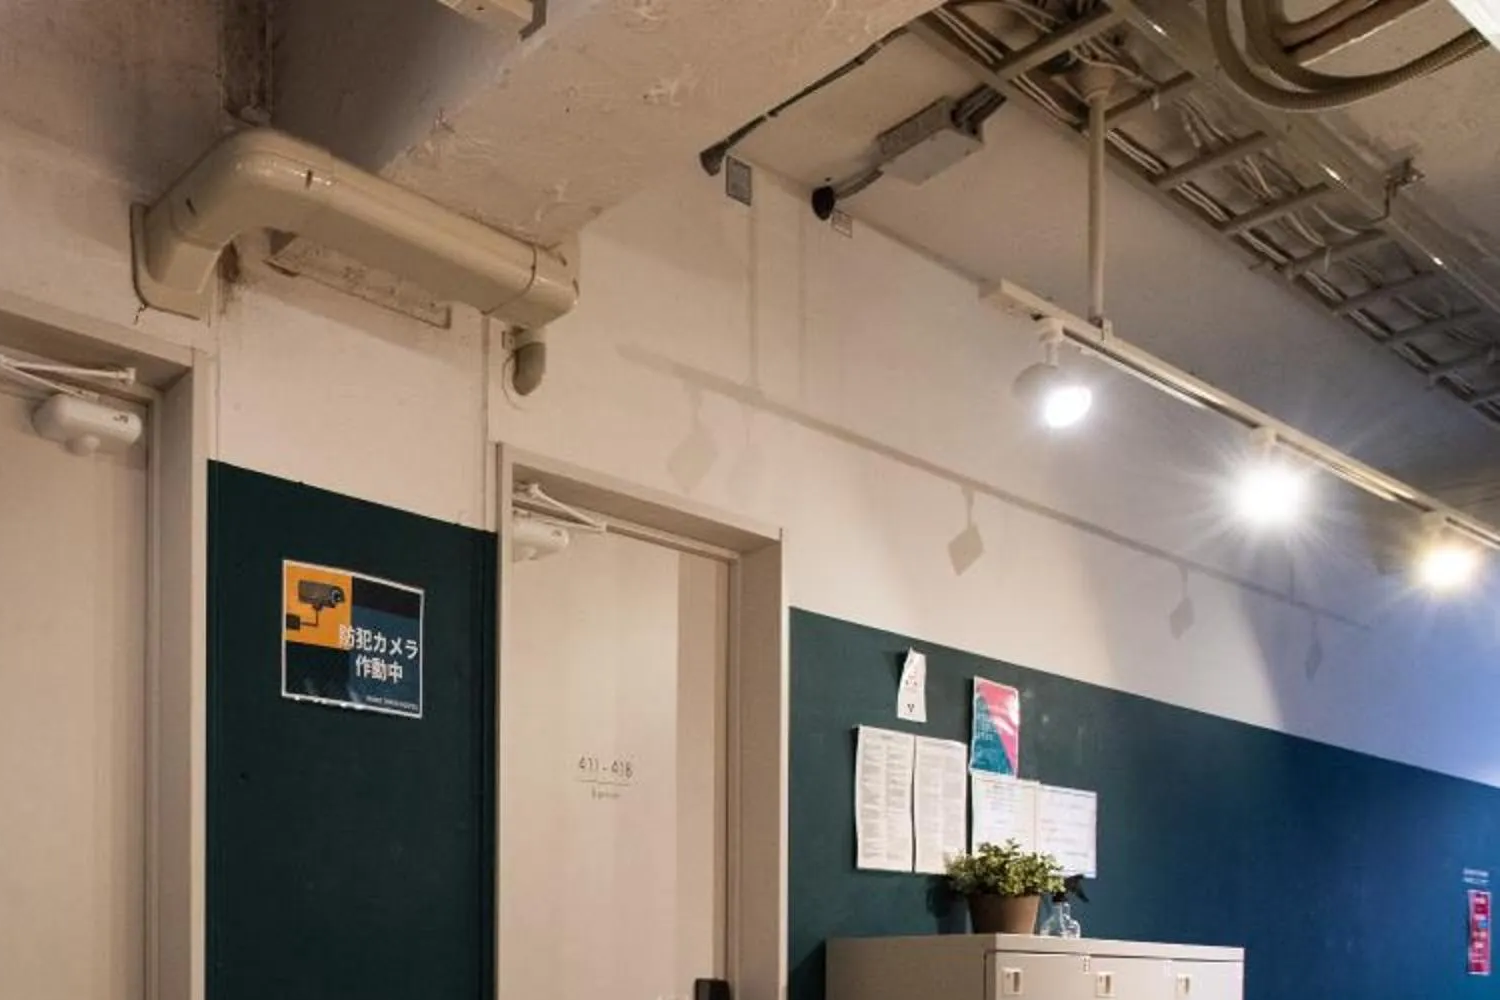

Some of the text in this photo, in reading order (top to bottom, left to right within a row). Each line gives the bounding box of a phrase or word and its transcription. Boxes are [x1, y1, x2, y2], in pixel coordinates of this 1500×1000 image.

[339, 623, 419, 660] 防犯カメラ
[355, 654, 403, 684] 作動中
